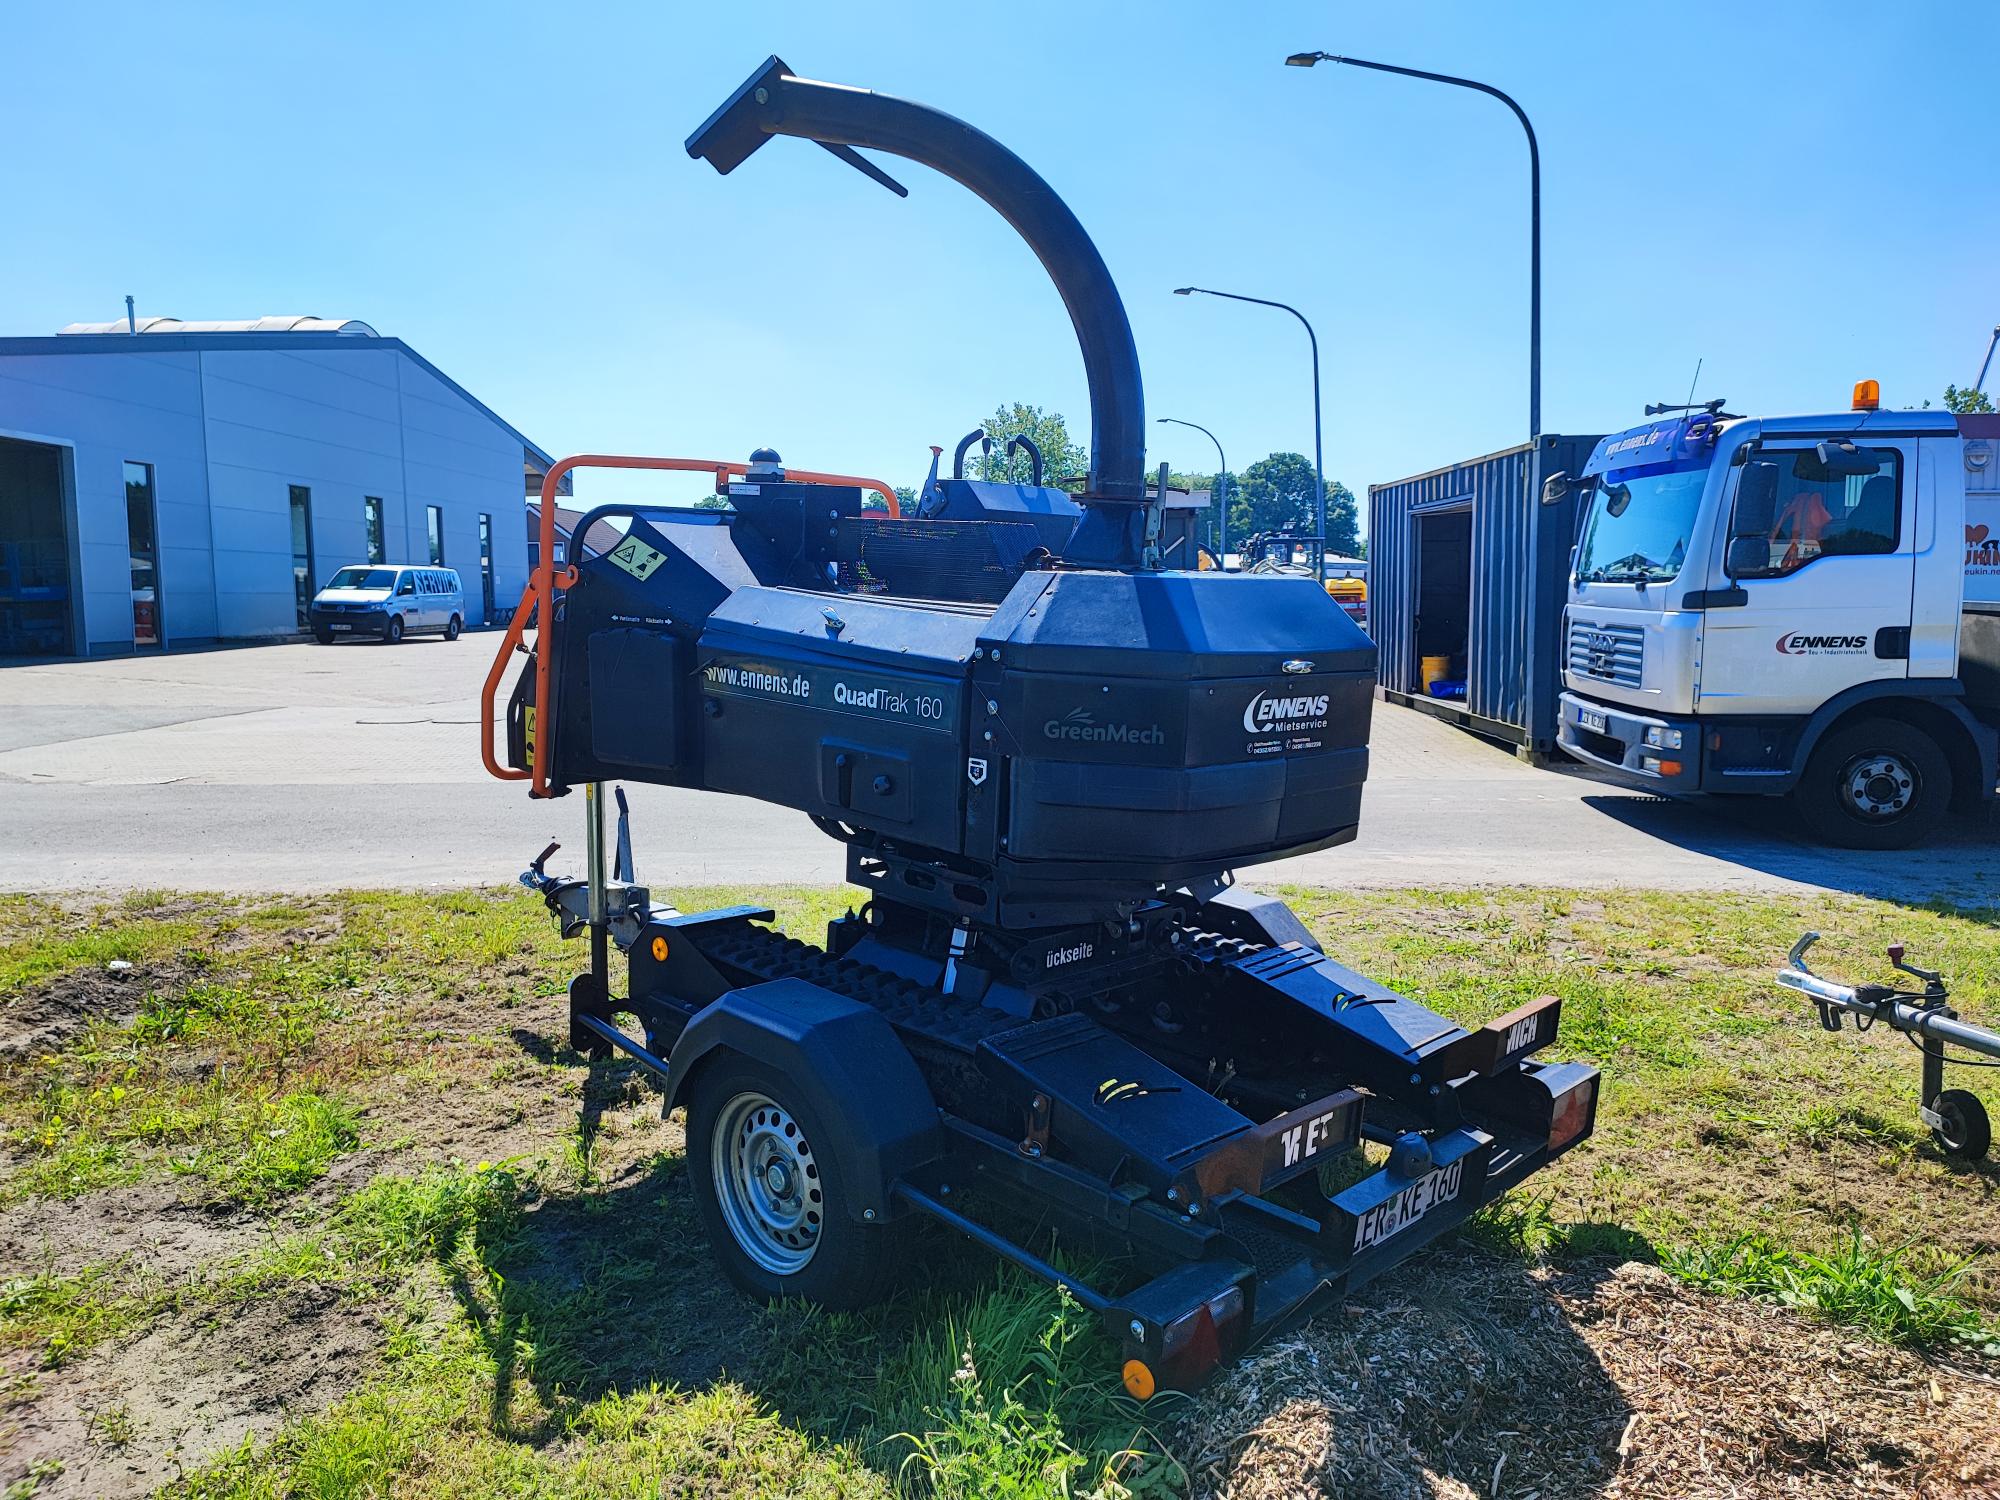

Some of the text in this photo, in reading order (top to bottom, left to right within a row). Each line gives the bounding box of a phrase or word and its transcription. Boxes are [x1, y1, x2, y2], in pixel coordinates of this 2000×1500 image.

[1789, 636, 1868, 648] ENNENS
[704, 667, 810, 698] www.ennens.de
[834, 682, 943, 720] QuadTrak 160
[1257, 695, 1330, 720] ENNENS
[1043, 720, 1165, 745] GreenMech
[1275, 719, 1328, 732] Mietservice
[1399, 1181, 1425, 1225] KE
[1425, 1163, 1460, 1209] 160
